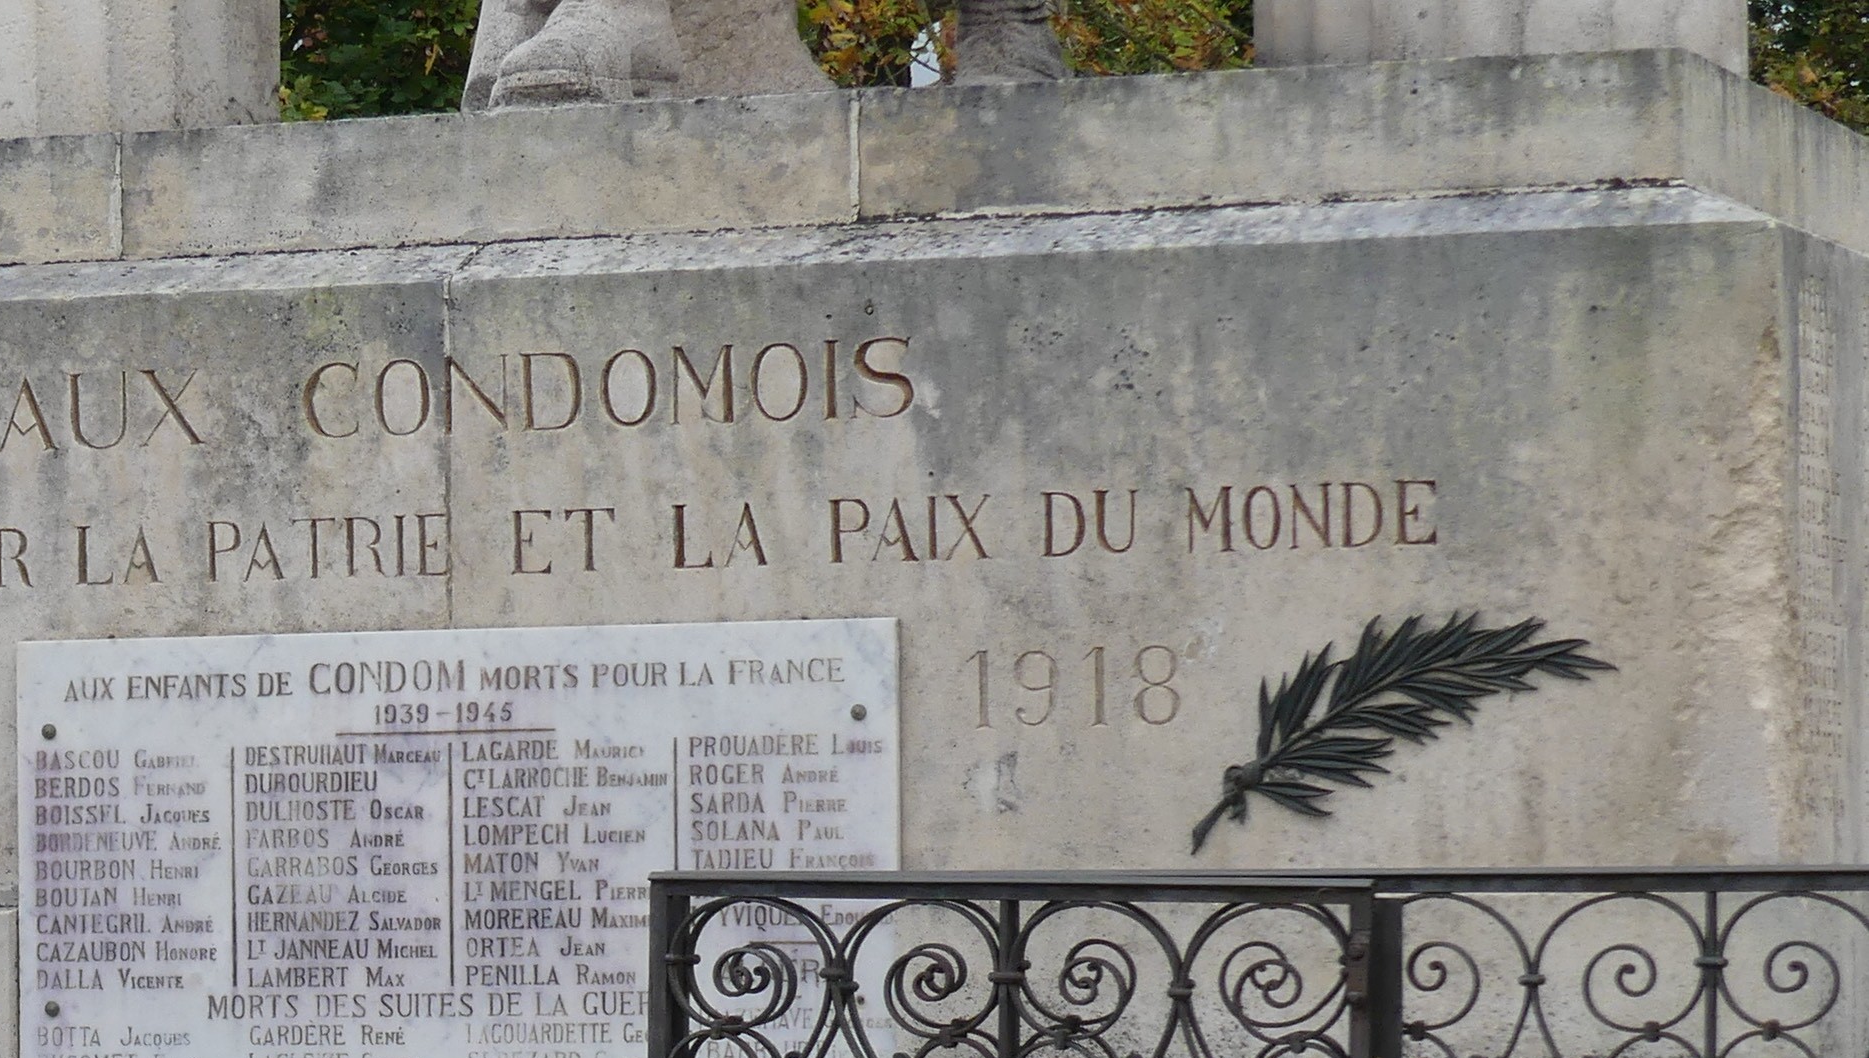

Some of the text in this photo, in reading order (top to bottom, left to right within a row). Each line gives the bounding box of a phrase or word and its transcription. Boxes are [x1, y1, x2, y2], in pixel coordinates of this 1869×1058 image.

[0, 336, 917, 453] AUX CONDOMOIS
[75, 524, 162, 586] LA
[206, 512, 451, 581] PATRIE
[511, 505, 617, 577] ET
[670, 503, 772, 570] LA
[827, 493, 993, 562] PAIX
[1041, 489, 1140, 558] DU
[1184, 480, 1440, 555] MONDE
[63, 657, 846, 703] AUX ENFANTS DE CONDOM MORTS POUR LA FRANCE
[963, 643, 1186, 730] 1918
[34, 749, 120, 771] BASCOU
[462, 739, 560, 762] LAGARDE
[488, 766, 589, 790] LARROCHE
[688, 763, 765, 785] ROGER
[34, 777, 121, 799] BERDOS
[139, 803, 211, 825] JACQUES
[245, 798, 426, 822] DULHOSTE OSCAR
[462, 794, 612, 819] LESCAT JEAN
[690, 791, 849, 815] SARDA PIERRE
[348, 827, 406, 849] ANDRÉ
[463, 822, 646, 848] LOMPECH LUCIEN
[690, 818, 845, 843] SOLANA PAUL
[34, 859, 200, 881] BOURBON HENRI
[246, 855, 439, 878] GARRABOS GEORGES
[463, 850, 600, 875] MATON YVAN
[690, 847, 775, 870] TADIEU
[34, 887, 183, 909] BOUTAN HENRI
[247, 884, 408, 906] GAZEAU ALCIDE
[490, 879, 581, 902] MENGEL
[595, 878, 650, 901] PIERR
[35, 913, 215, 935] CANTEGRIL ANDRÉ
[246, 909, 442, 933] HERNANDEZ SALVADOR
[464, 906, 650, 931] MOREREAU MAXIM
[36, 940, 219, 963] CAZAUBON HONORÉ
[273, 937, 370, 961] JANNEAU
[376, 938, 439, 960] MICHEL
[466, 935, 606, 958] ORTEA JEAN
[36, 967, 186, 991] DALLA VICENTE
[247, 965, 406, 989] LAMBERT MAX
[466, 962, 637, 987] PENILLA RAMON
[207, 994, 300, 1020] MORTS
[315, 993, 368, 1019] DES
[377, 992, 475, 1019] SUITES
[487, 992, 525, 1018] DE
[534, 991, 569, 1017] LA
[36, 1025, 192, 1050] BOTTA JACQUES
[248, 1019, 407, 1047] GARDÈRE RENÉ
